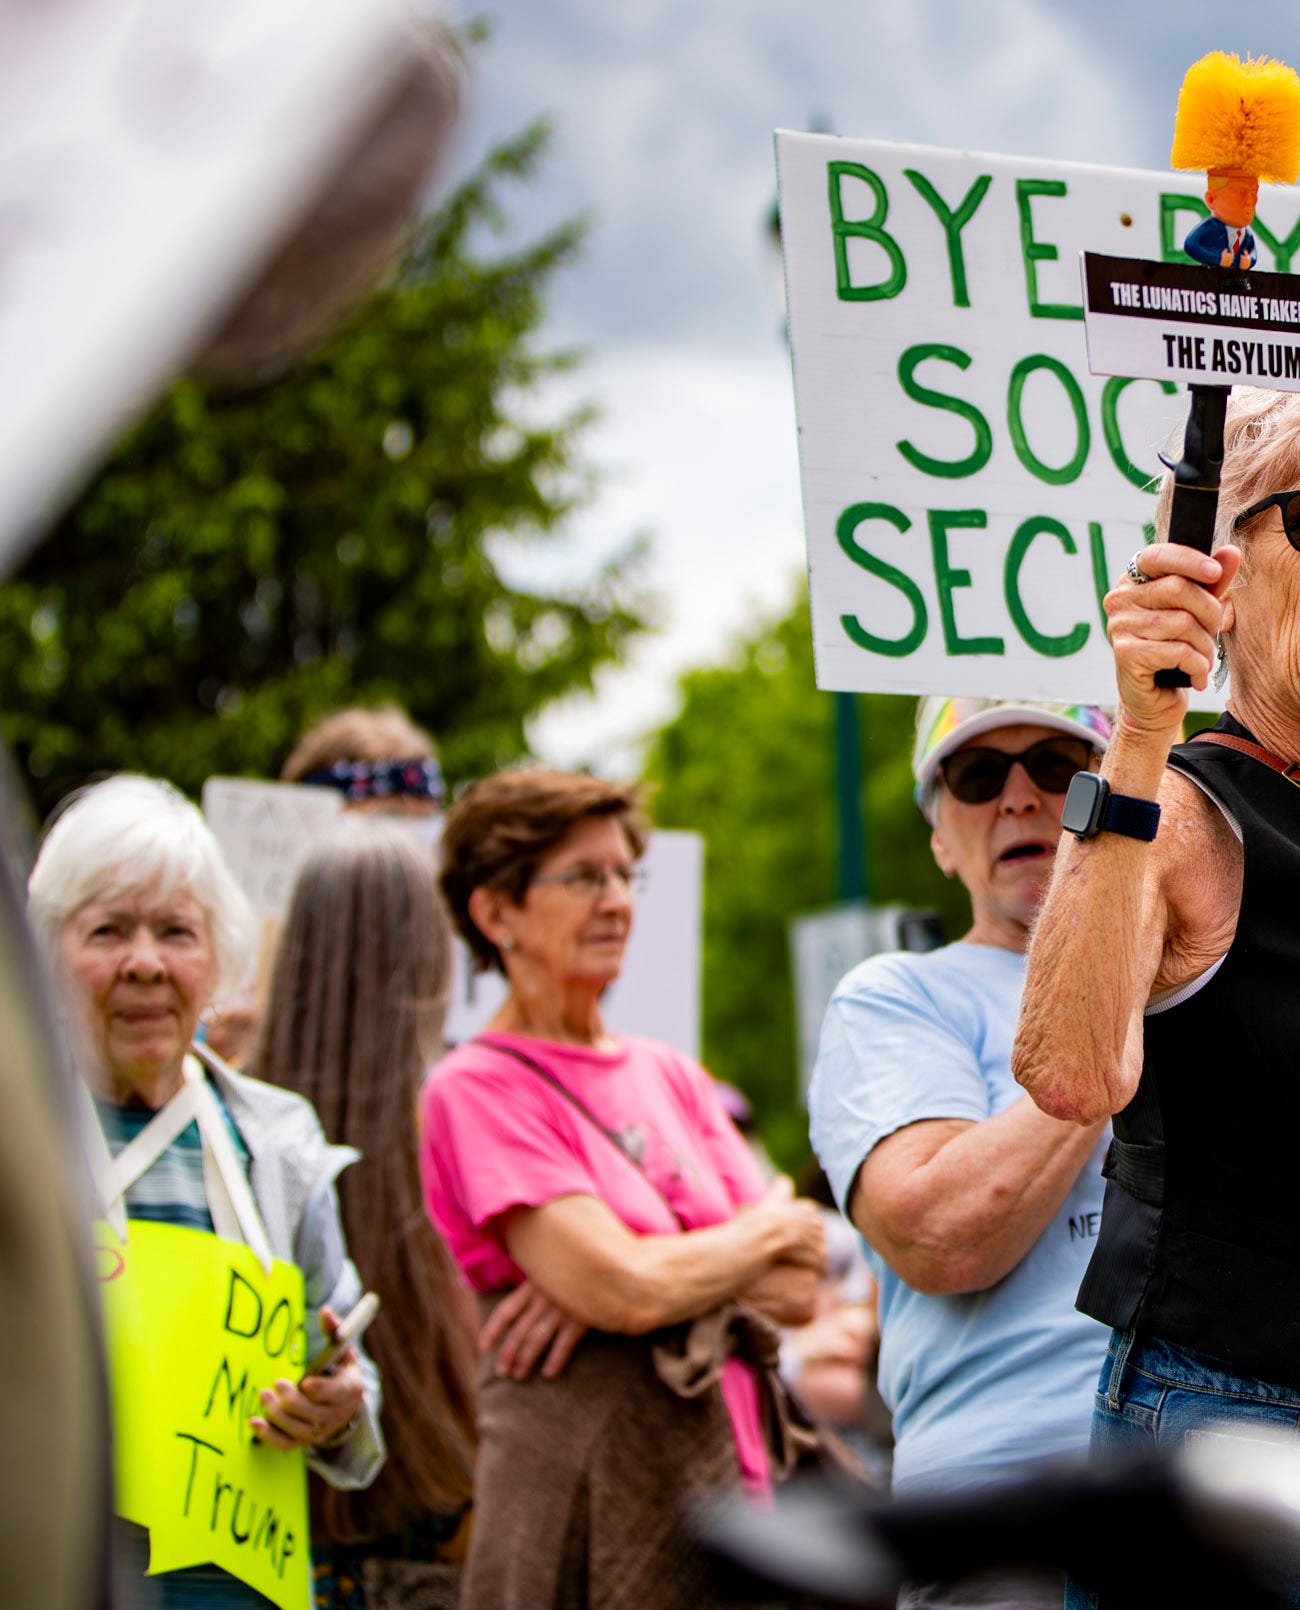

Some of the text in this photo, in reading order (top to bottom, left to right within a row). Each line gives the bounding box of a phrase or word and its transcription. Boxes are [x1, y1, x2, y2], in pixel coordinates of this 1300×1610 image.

[826, 160, 1087, 321] BYE
[1110, 281, 1141, 307] THE
[1141, 285, 1218, 316] LUNATICS
[1218, 292, 1260, 321] HAVE
[1162, 334, 1206, 370] THE
